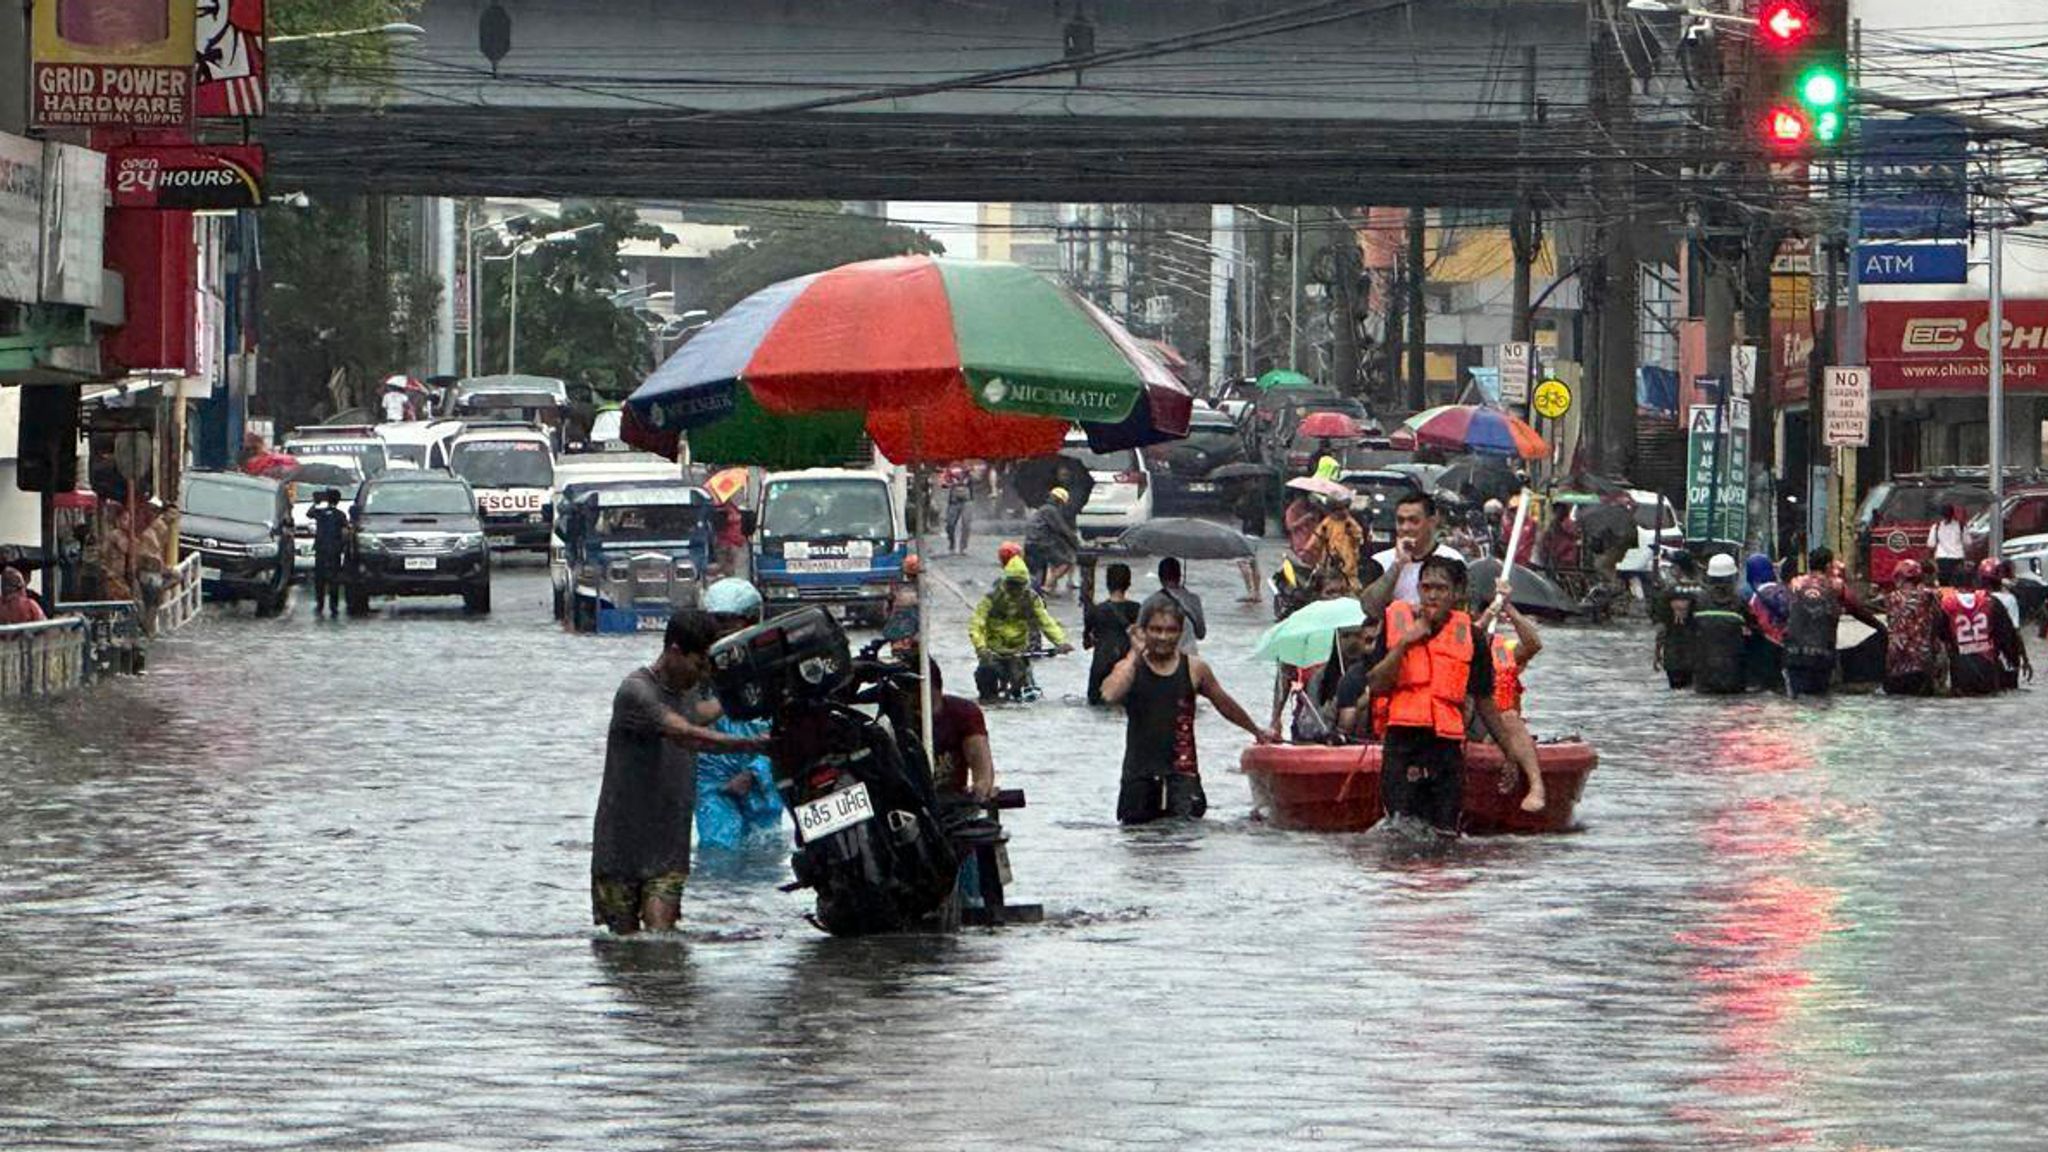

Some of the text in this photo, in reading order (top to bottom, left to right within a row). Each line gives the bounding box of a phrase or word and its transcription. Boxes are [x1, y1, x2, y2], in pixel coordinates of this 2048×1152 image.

[39, 67, 187, 97] GRID POWER
[43, 95, 183, 114] HARDWARE
[49, 111, 130, 123] INDUSTRIAL
[134, 112, 185, 124] SUPPLY
[117, 170, 156, 192] 24
[1865, 255, 1914, 275] ATM
[1504, 344, 1521, 357] NO
[1835, 373, 1859, 387] NO
[1902, 363, 2038, 378] www.chinabk.ph
[478, 495, 540, 509] ESCUE
[1955, 612, 1988, 642] 22
[804, 791, 868, 829] 685 UHG
